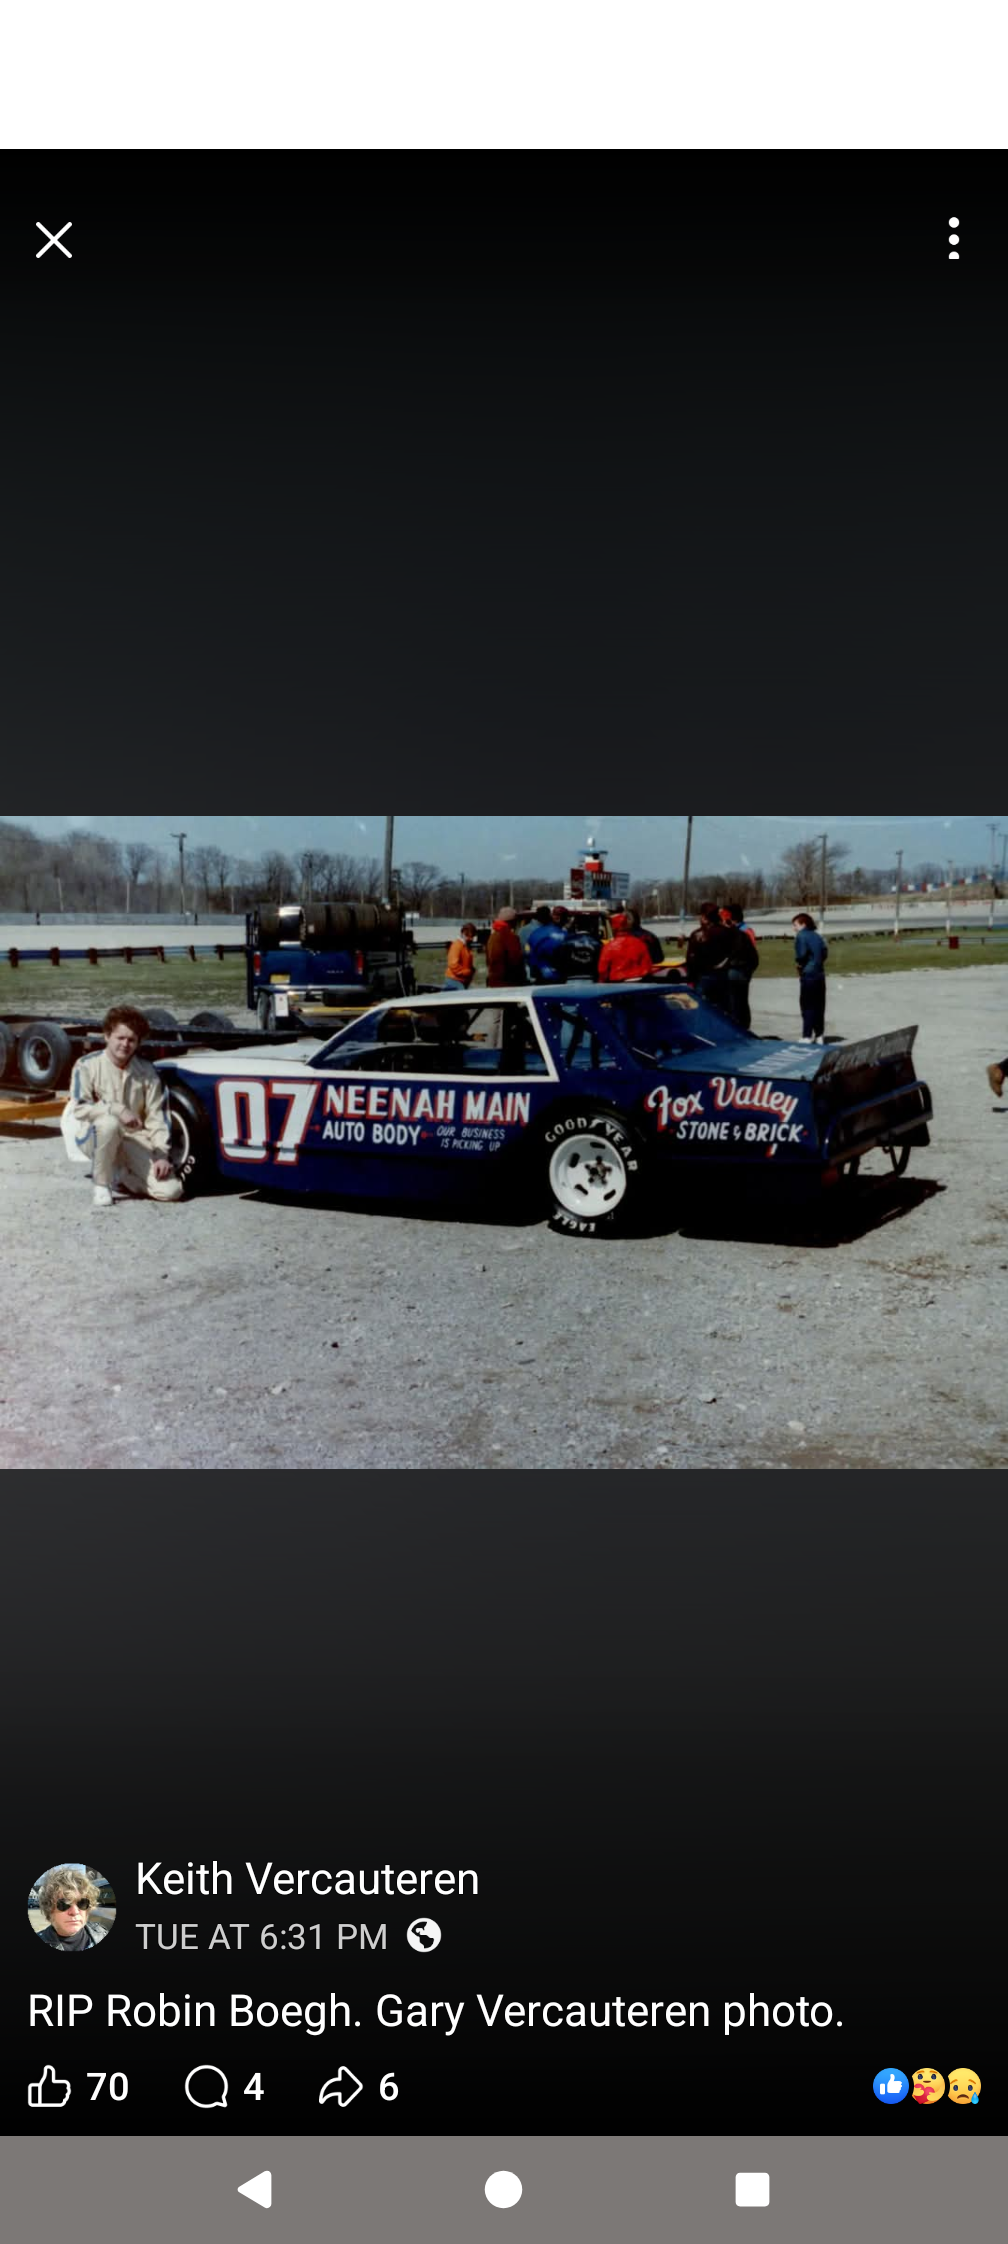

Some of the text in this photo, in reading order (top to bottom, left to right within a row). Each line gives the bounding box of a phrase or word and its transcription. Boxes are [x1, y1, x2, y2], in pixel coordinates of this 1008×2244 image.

[323, 1085, 531, 1127] NEENAH MAIN
[644, 1076, 799, 1157] Fox Valley
[215, 1077, 321, 1166] 07
[322, 1120, 421, 1146] AUTO BODY
[436, 1125, 506, 1140] OUR BUSINESS
[676, 1121, 730, 1141] STONE
[744, 1122, 804, 1143] BRICK
[440, 1138, 501, 1153] IS PICKING UP
